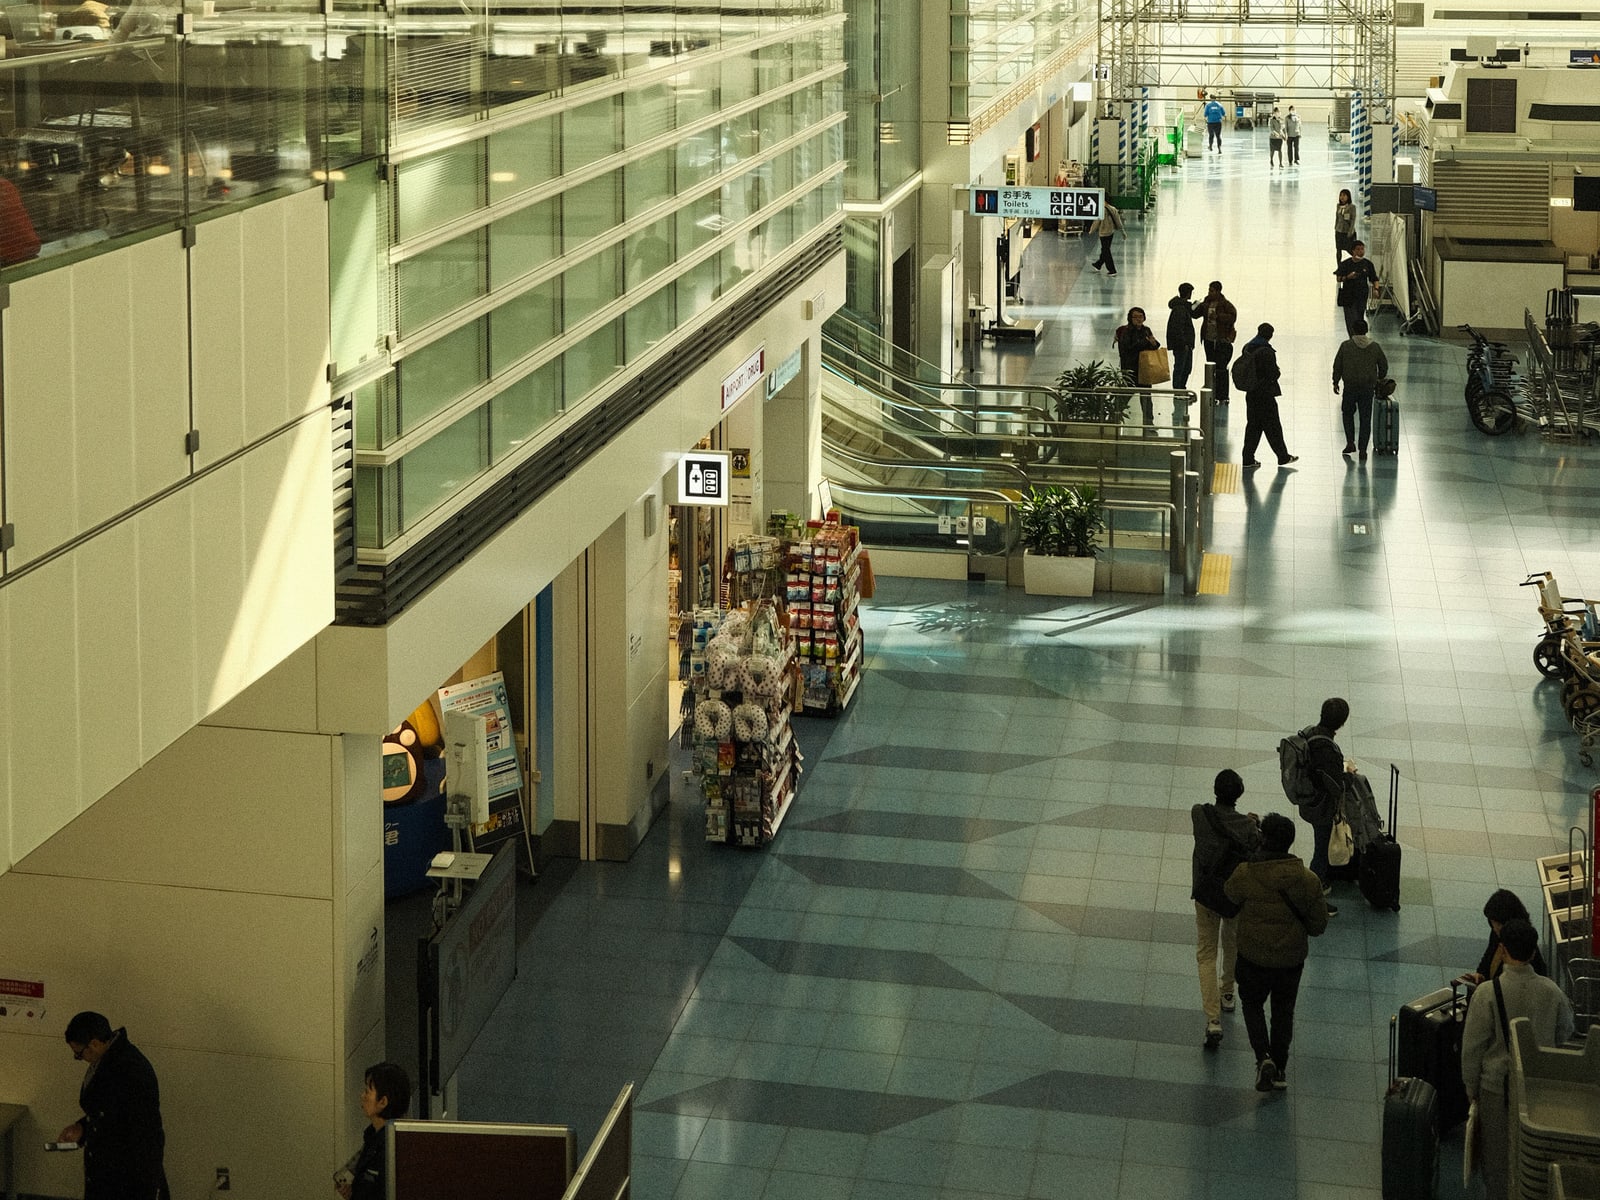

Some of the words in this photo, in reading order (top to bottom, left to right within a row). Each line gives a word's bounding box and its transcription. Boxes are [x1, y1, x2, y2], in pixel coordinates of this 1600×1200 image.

[1003, 190, 1032, 200] お手洗
[1003, 200, 1029, 208] Toilets
[725, 373, 744, 401] AIRPORT
[747, 359, 760, 380] DRUG
